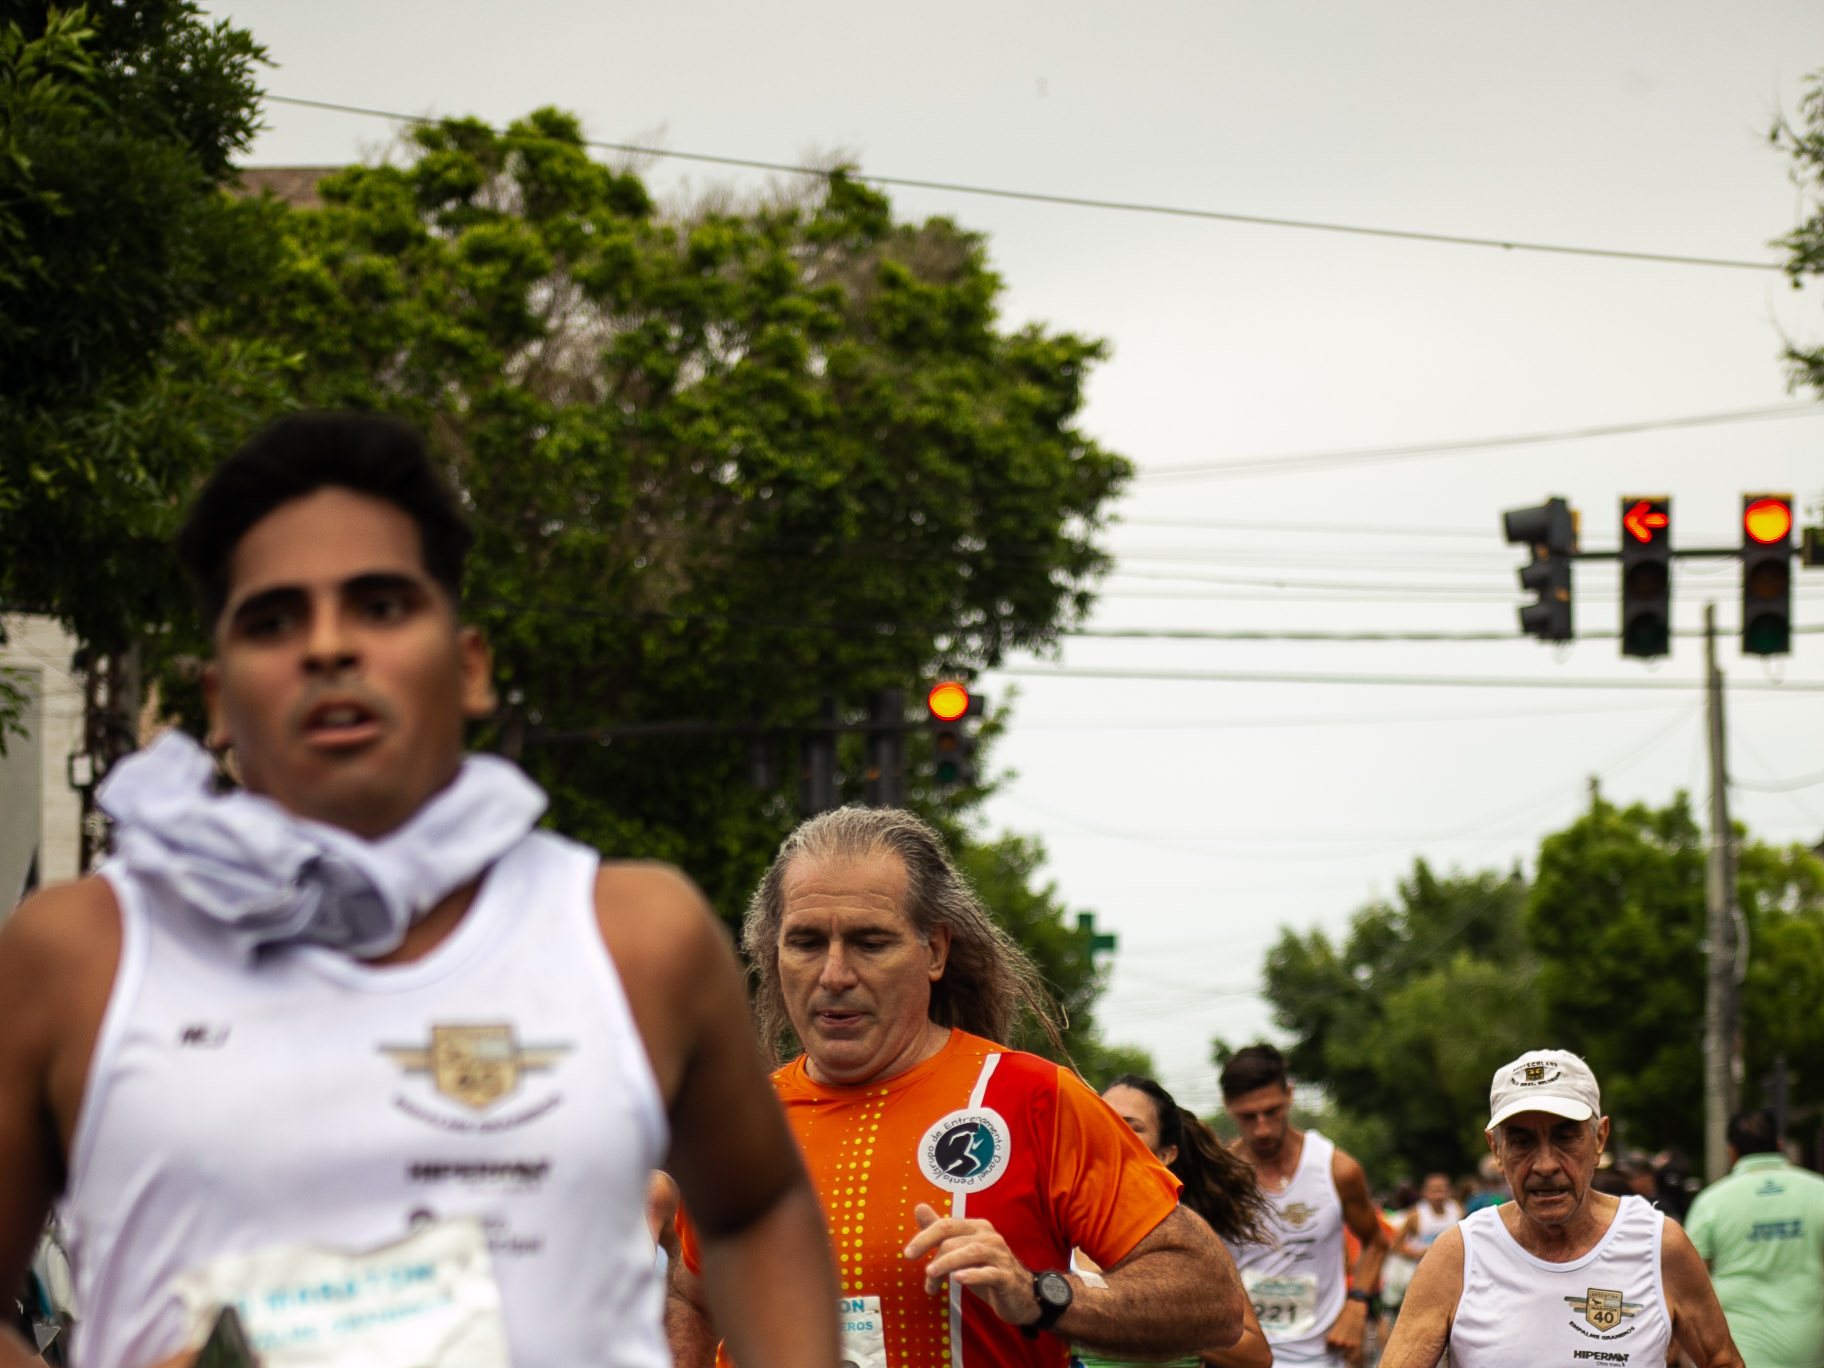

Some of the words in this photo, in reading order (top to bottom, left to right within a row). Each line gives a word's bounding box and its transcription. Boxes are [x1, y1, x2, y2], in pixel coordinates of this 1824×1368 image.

[930, 1131, 942, 1143] de
[1593, 1311, 1614, 1324] 40
[1568, 1320, 1600, 1340] EMPALME
[1601, 1326, 1635, 1340] GRANEROS
